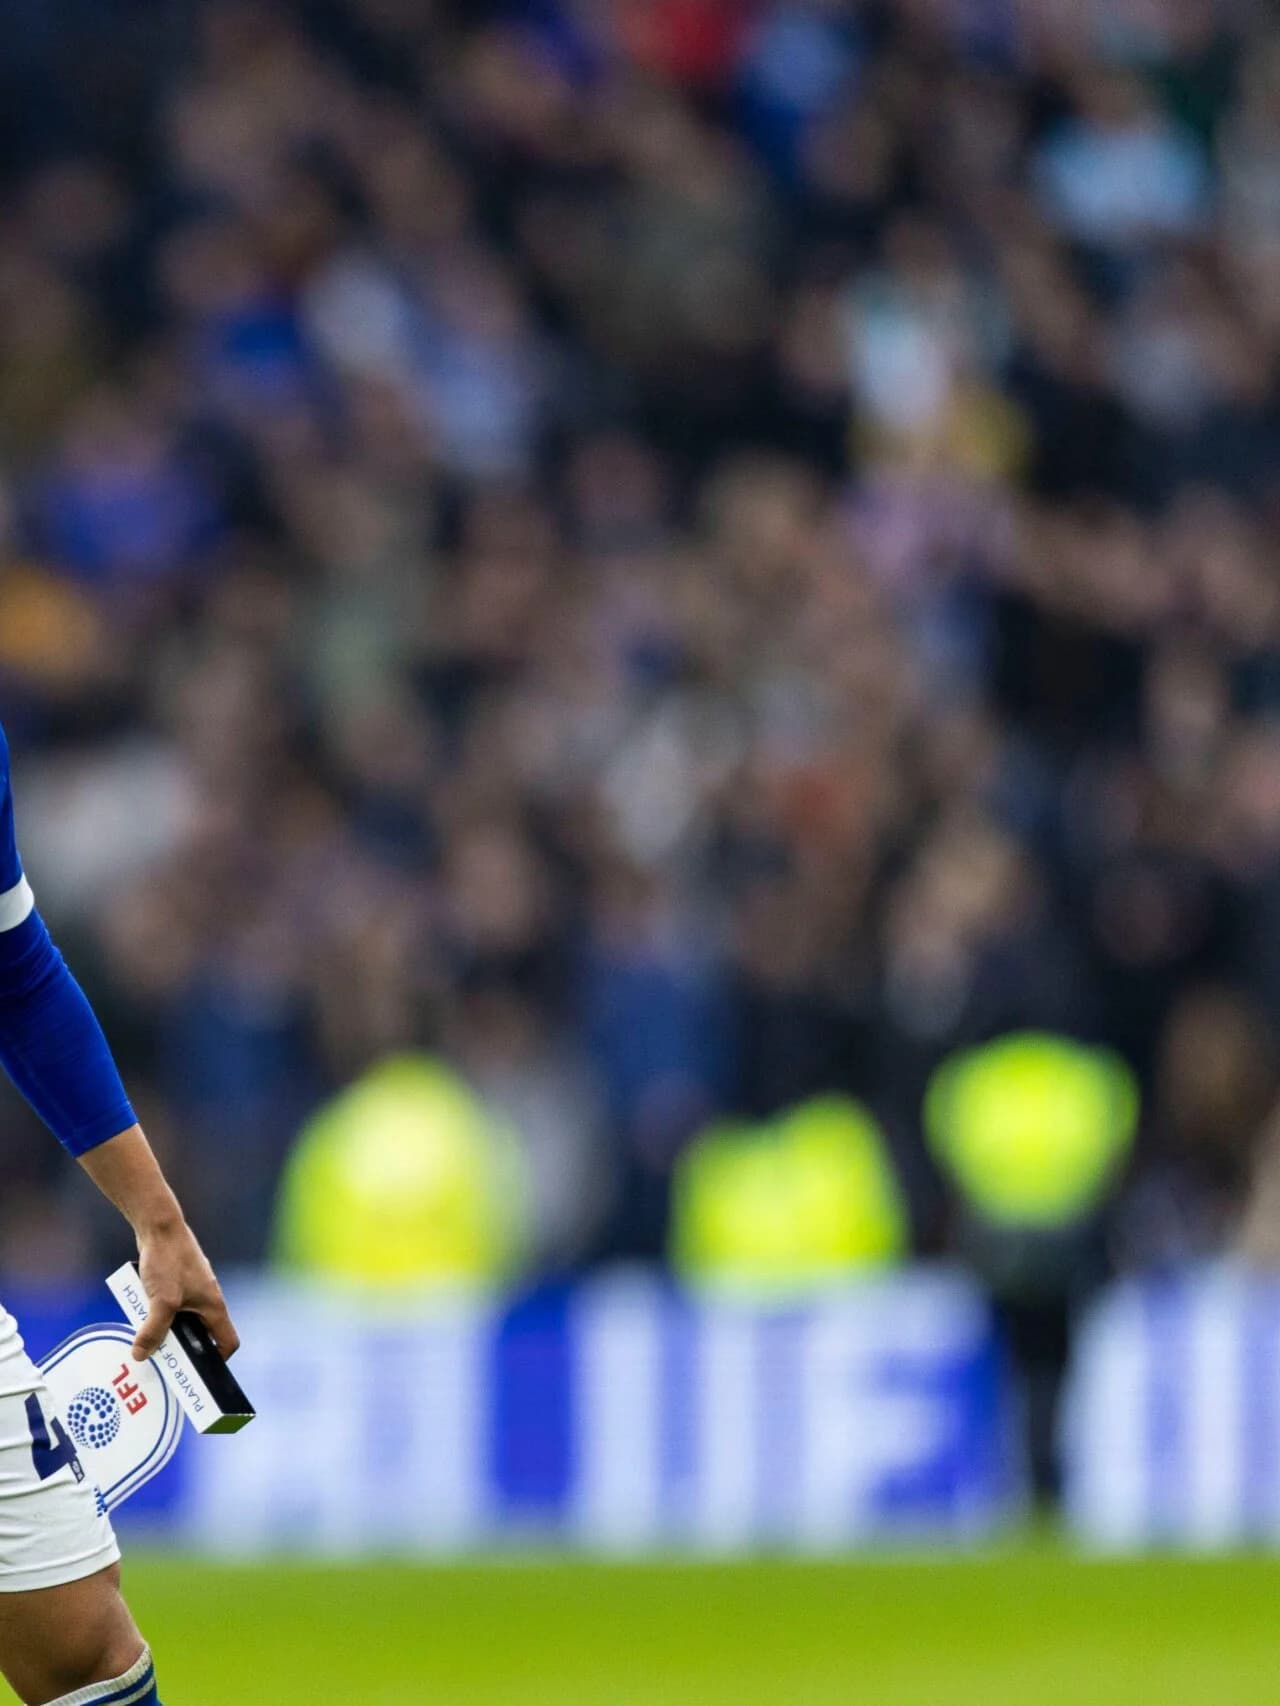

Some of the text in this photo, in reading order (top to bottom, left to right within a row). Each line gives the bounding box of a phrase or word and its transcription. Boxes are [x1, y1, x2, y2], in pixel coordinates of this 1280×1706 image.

[162, 1351, 178, 1369] OF
[112, 1363, 148, 1415] EFL
[174, 1369, 205, 1413] PLAYER
[24, 1392, 77, 1480] 4
